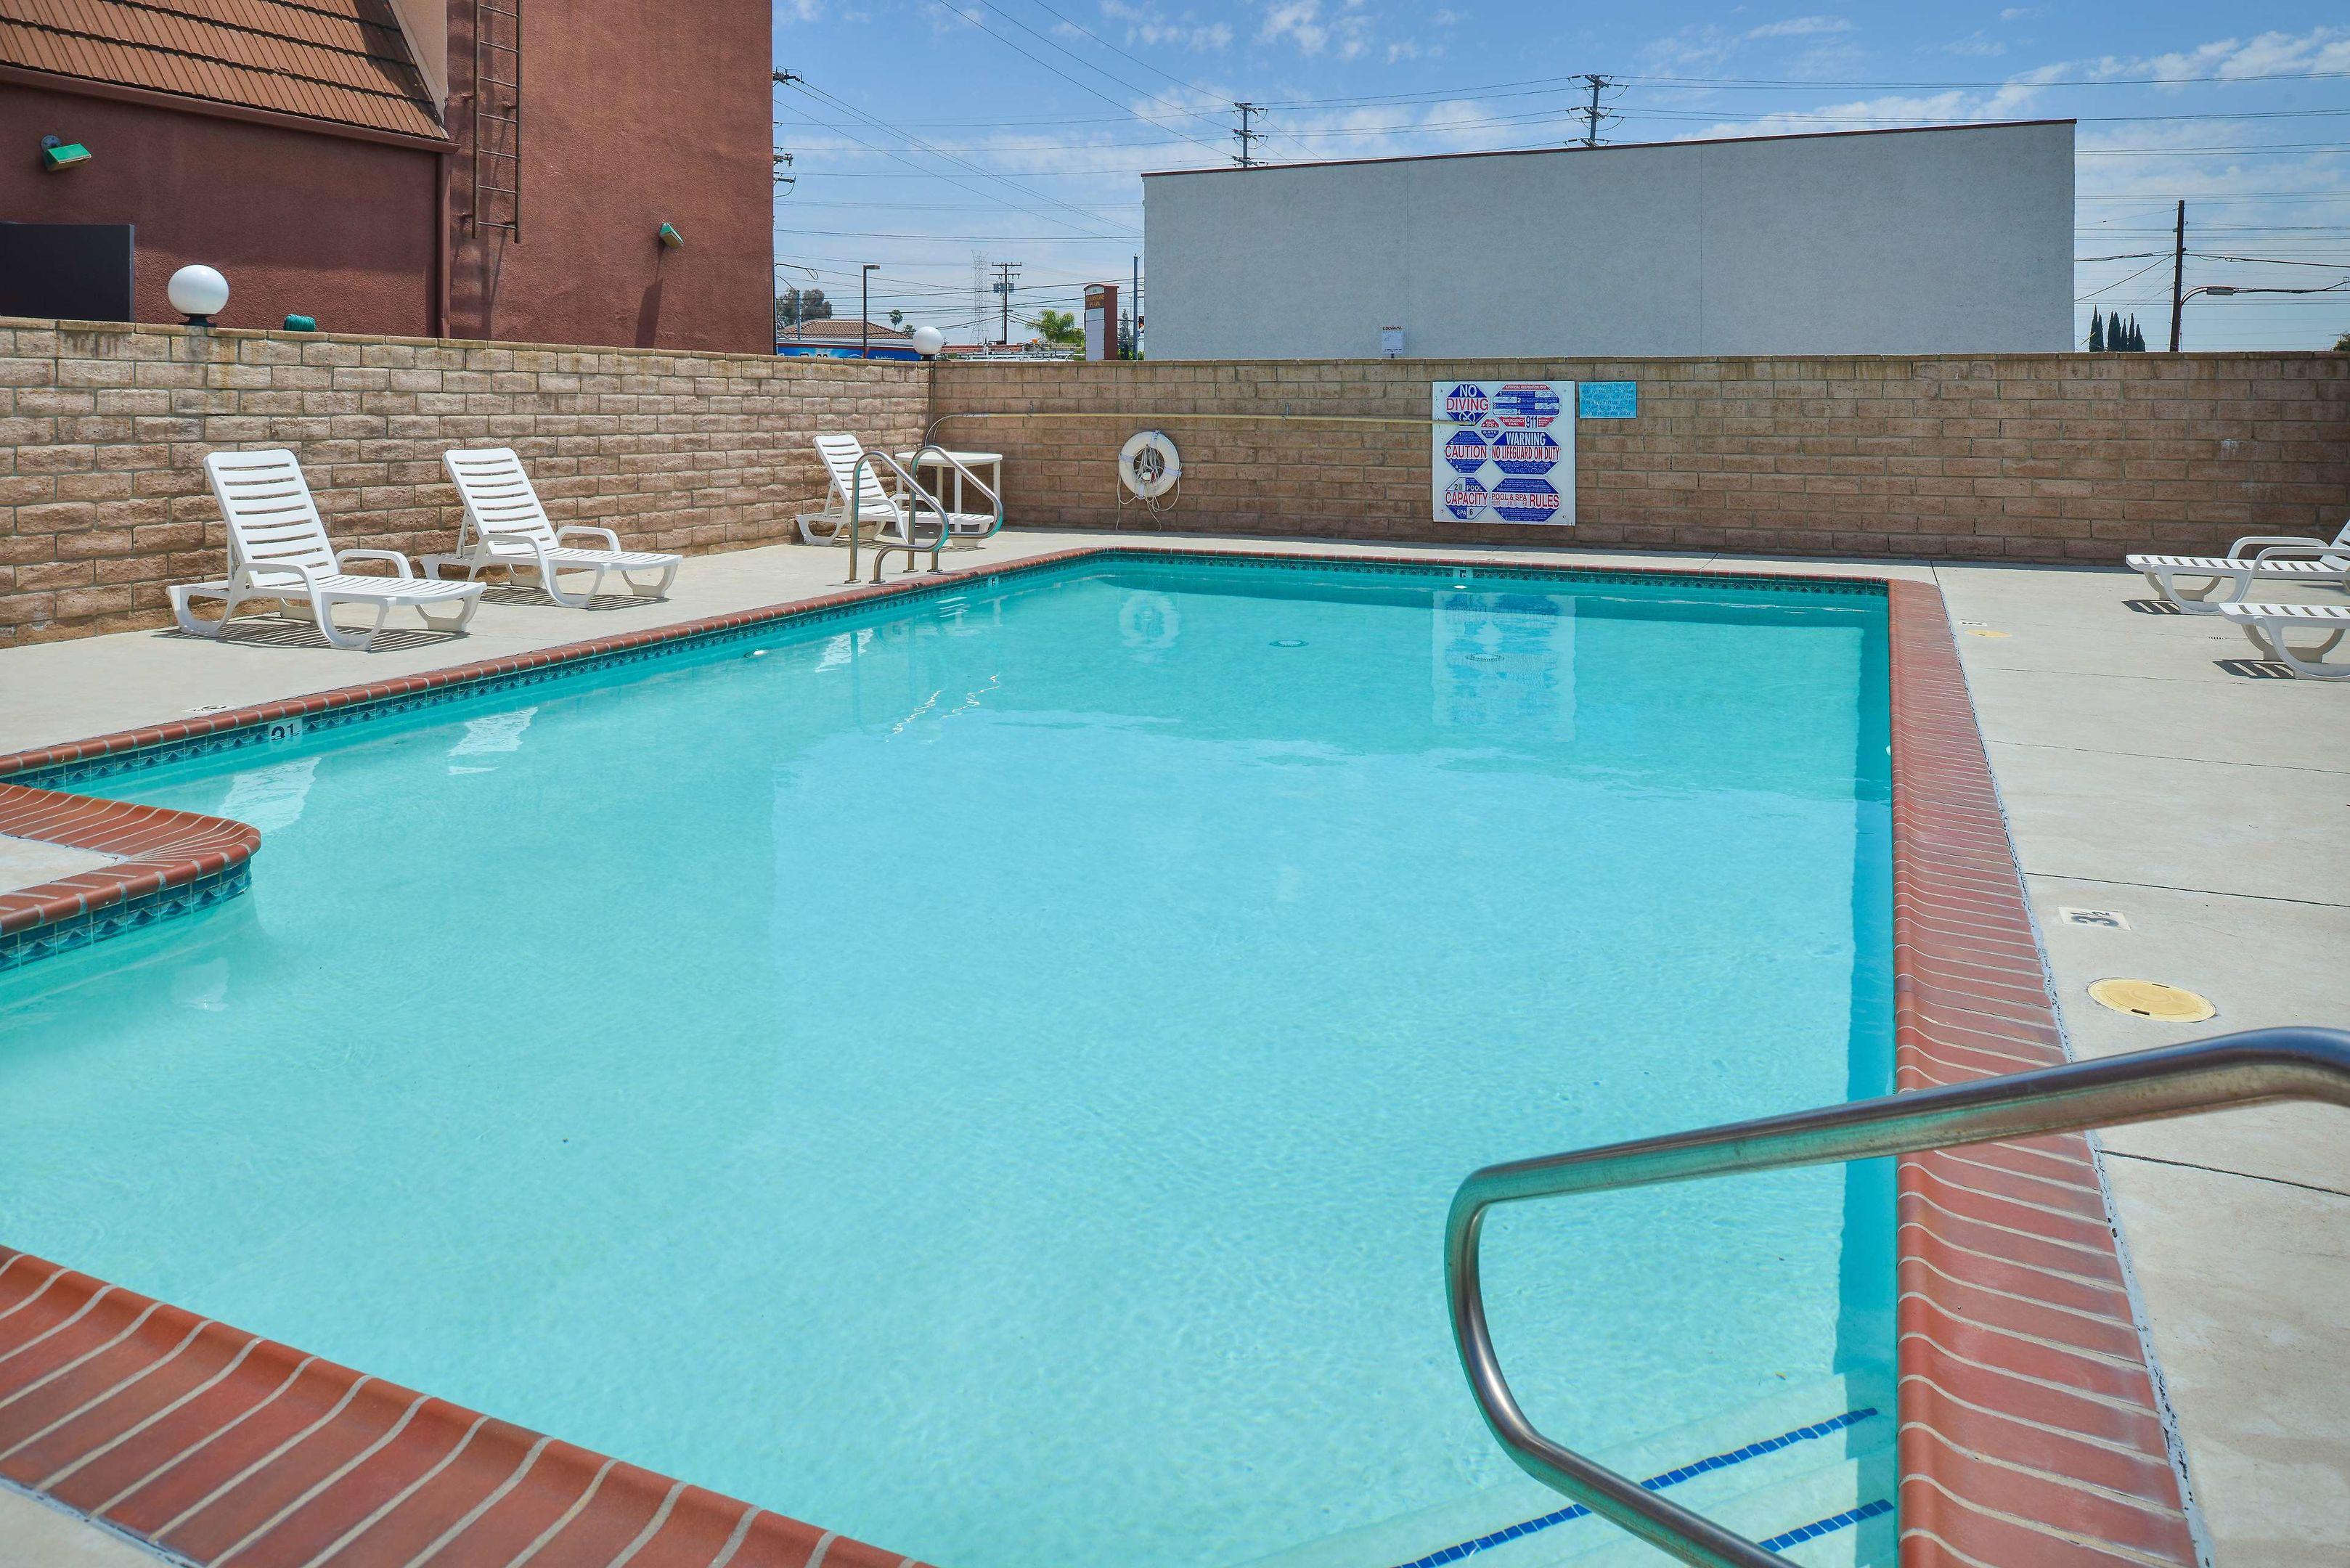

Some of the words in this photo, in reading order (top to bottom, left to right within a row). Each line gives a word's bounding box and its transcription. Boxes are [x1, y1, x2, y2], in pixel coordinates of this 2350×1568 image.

[1460, 385, 1477, 397] NO
[1447, 399, 1488, 410] DIVING
[1526, 416, 1538, 428] 911
[1506, 432, 1546, 446] WARNING
[1445, 445, 1487, 458] CAUTION
[1492, 446, 1500, 459] NO
[1502, 446, 1532, 460] LIFEGUARD
[1534, 446, 1543, 460] ON
[1545, 447, 1560, 460] DUTY
[1445, 492, 1488, 505] CAPACITY
[1530, 494, 1559, 507] RULES
